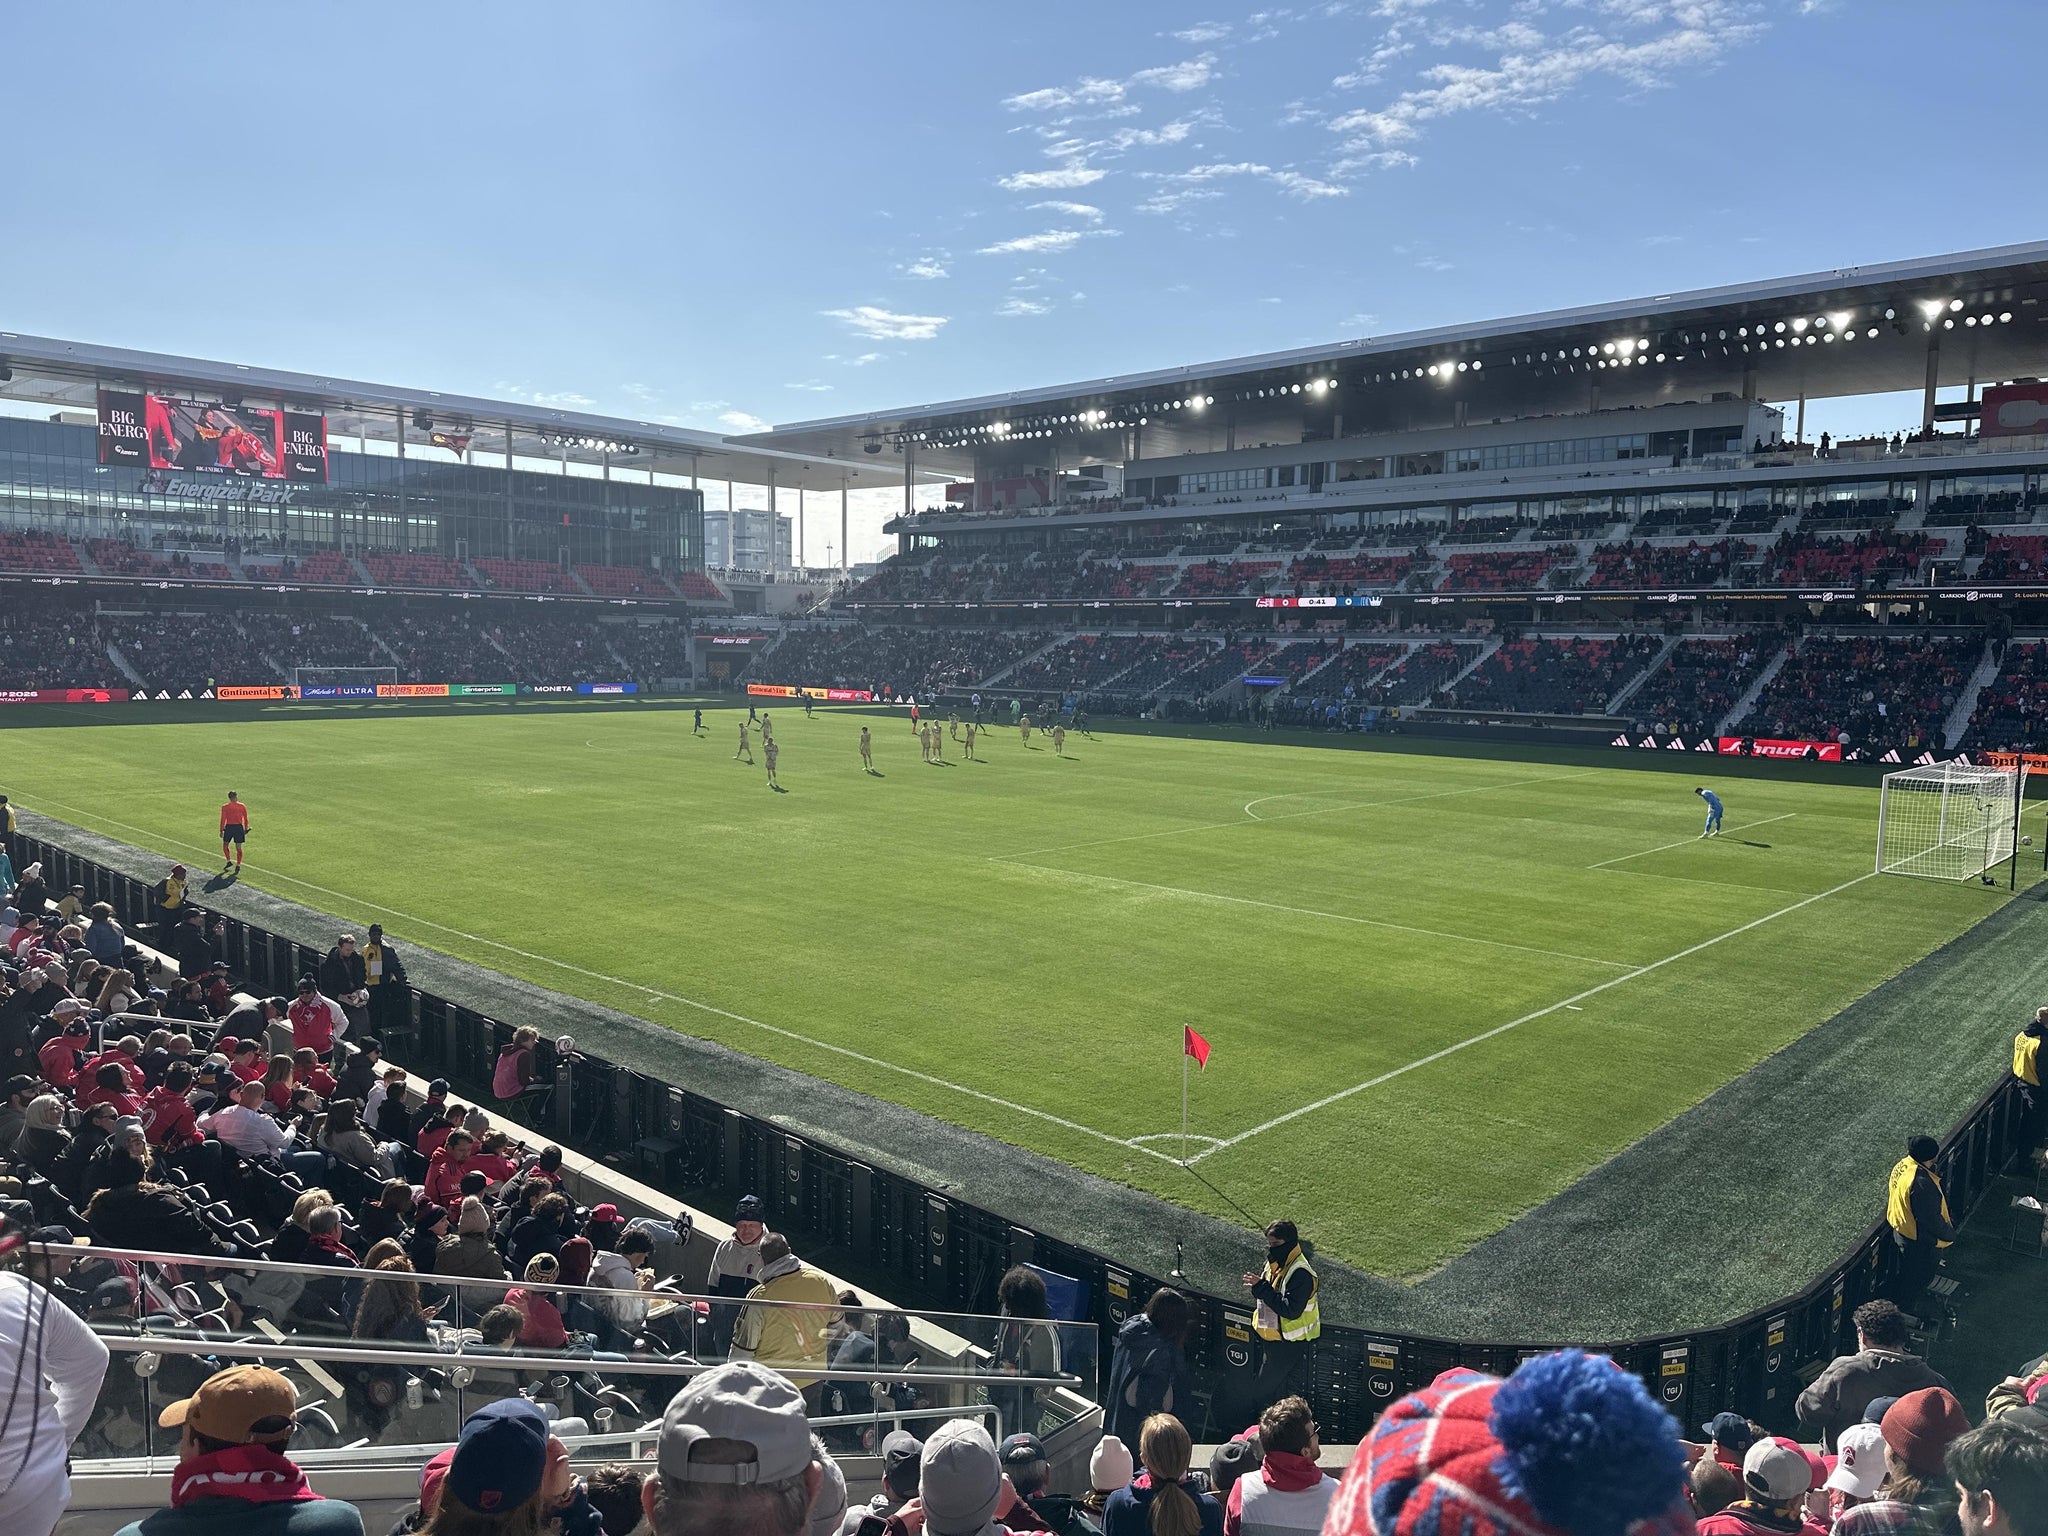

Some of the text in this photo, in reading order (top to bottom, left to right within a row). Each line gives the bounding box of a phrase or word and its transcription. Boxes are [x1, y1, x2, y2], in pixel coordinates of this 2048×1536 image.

[111, 410, 134, 424] BIG
[100, 422, 152, 440] ENERGY
[294, 430, 313, 443] BIG
[284, 442, 327, 458] ENERGY
[166, 480, 295, 504] Energizer Park
[219, 687, 270, 698] Continental
[828, 690, 853, 699] Energizer
[1230, 1350, 1242, 1360] TGI
[1372, 1381, 1388, 1390] TGI
[1666, 1386, 1678, 1395] TGI
